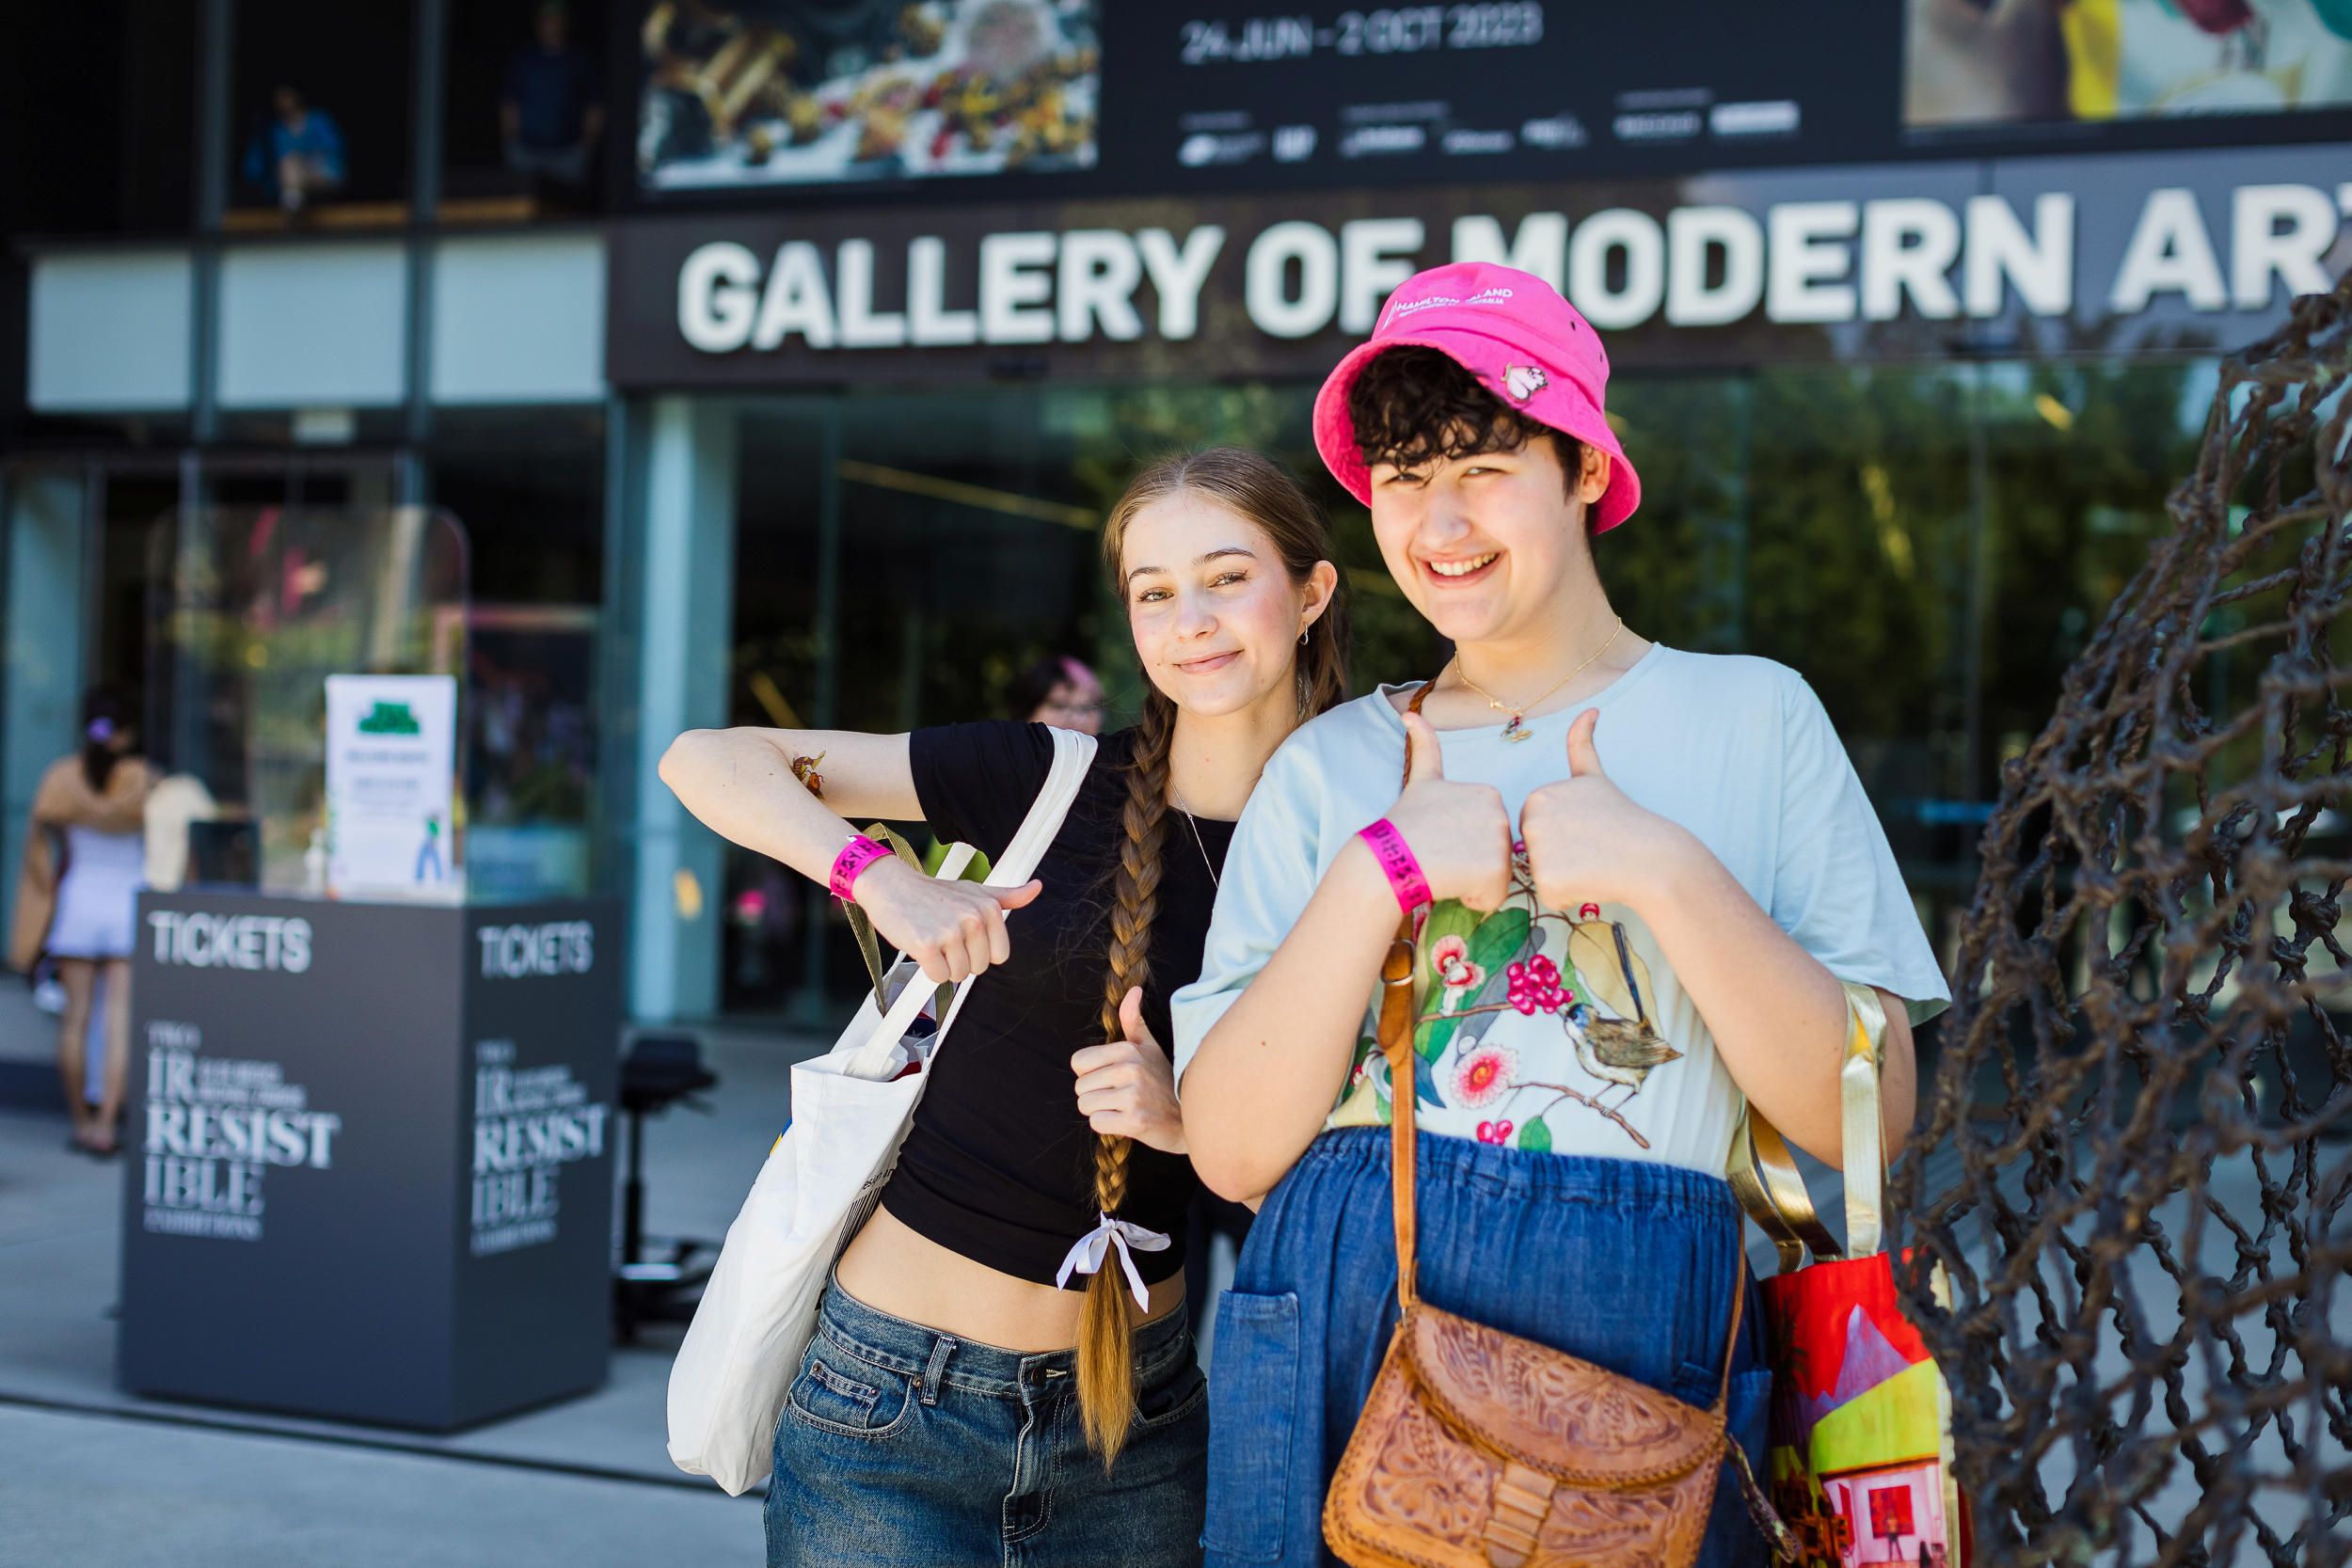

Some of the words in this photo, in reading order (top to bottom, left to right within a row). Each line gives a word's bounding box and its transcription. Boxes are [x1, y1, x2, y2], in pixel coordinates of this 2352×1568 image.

[1230, 14, 1312, 61] JUN
[1336, 10, 1365, 55] 2
[1366, 6, 1442, 53] OCT
[676, 224, 1227, 354] GALLERY
[1244, 216, 1426, 340] OF
[1451, 188, 2074, 331] MODERN
[1396, 296, 1460, 311] HAMILTON
[148, 910, 313, 973] TICKETS
[476, 921, 595, 979] TICKETS
[146, 1046, 195, 1104] IR
[475, 1066, 514, 1117] IR
[145, 1103, 342, 1169] RESIST
[473, 1101, 609, 1175] RESIST
[145, 1154, 265, 1215] IBLE
[471, 1164, 561, 1227] IBLE
